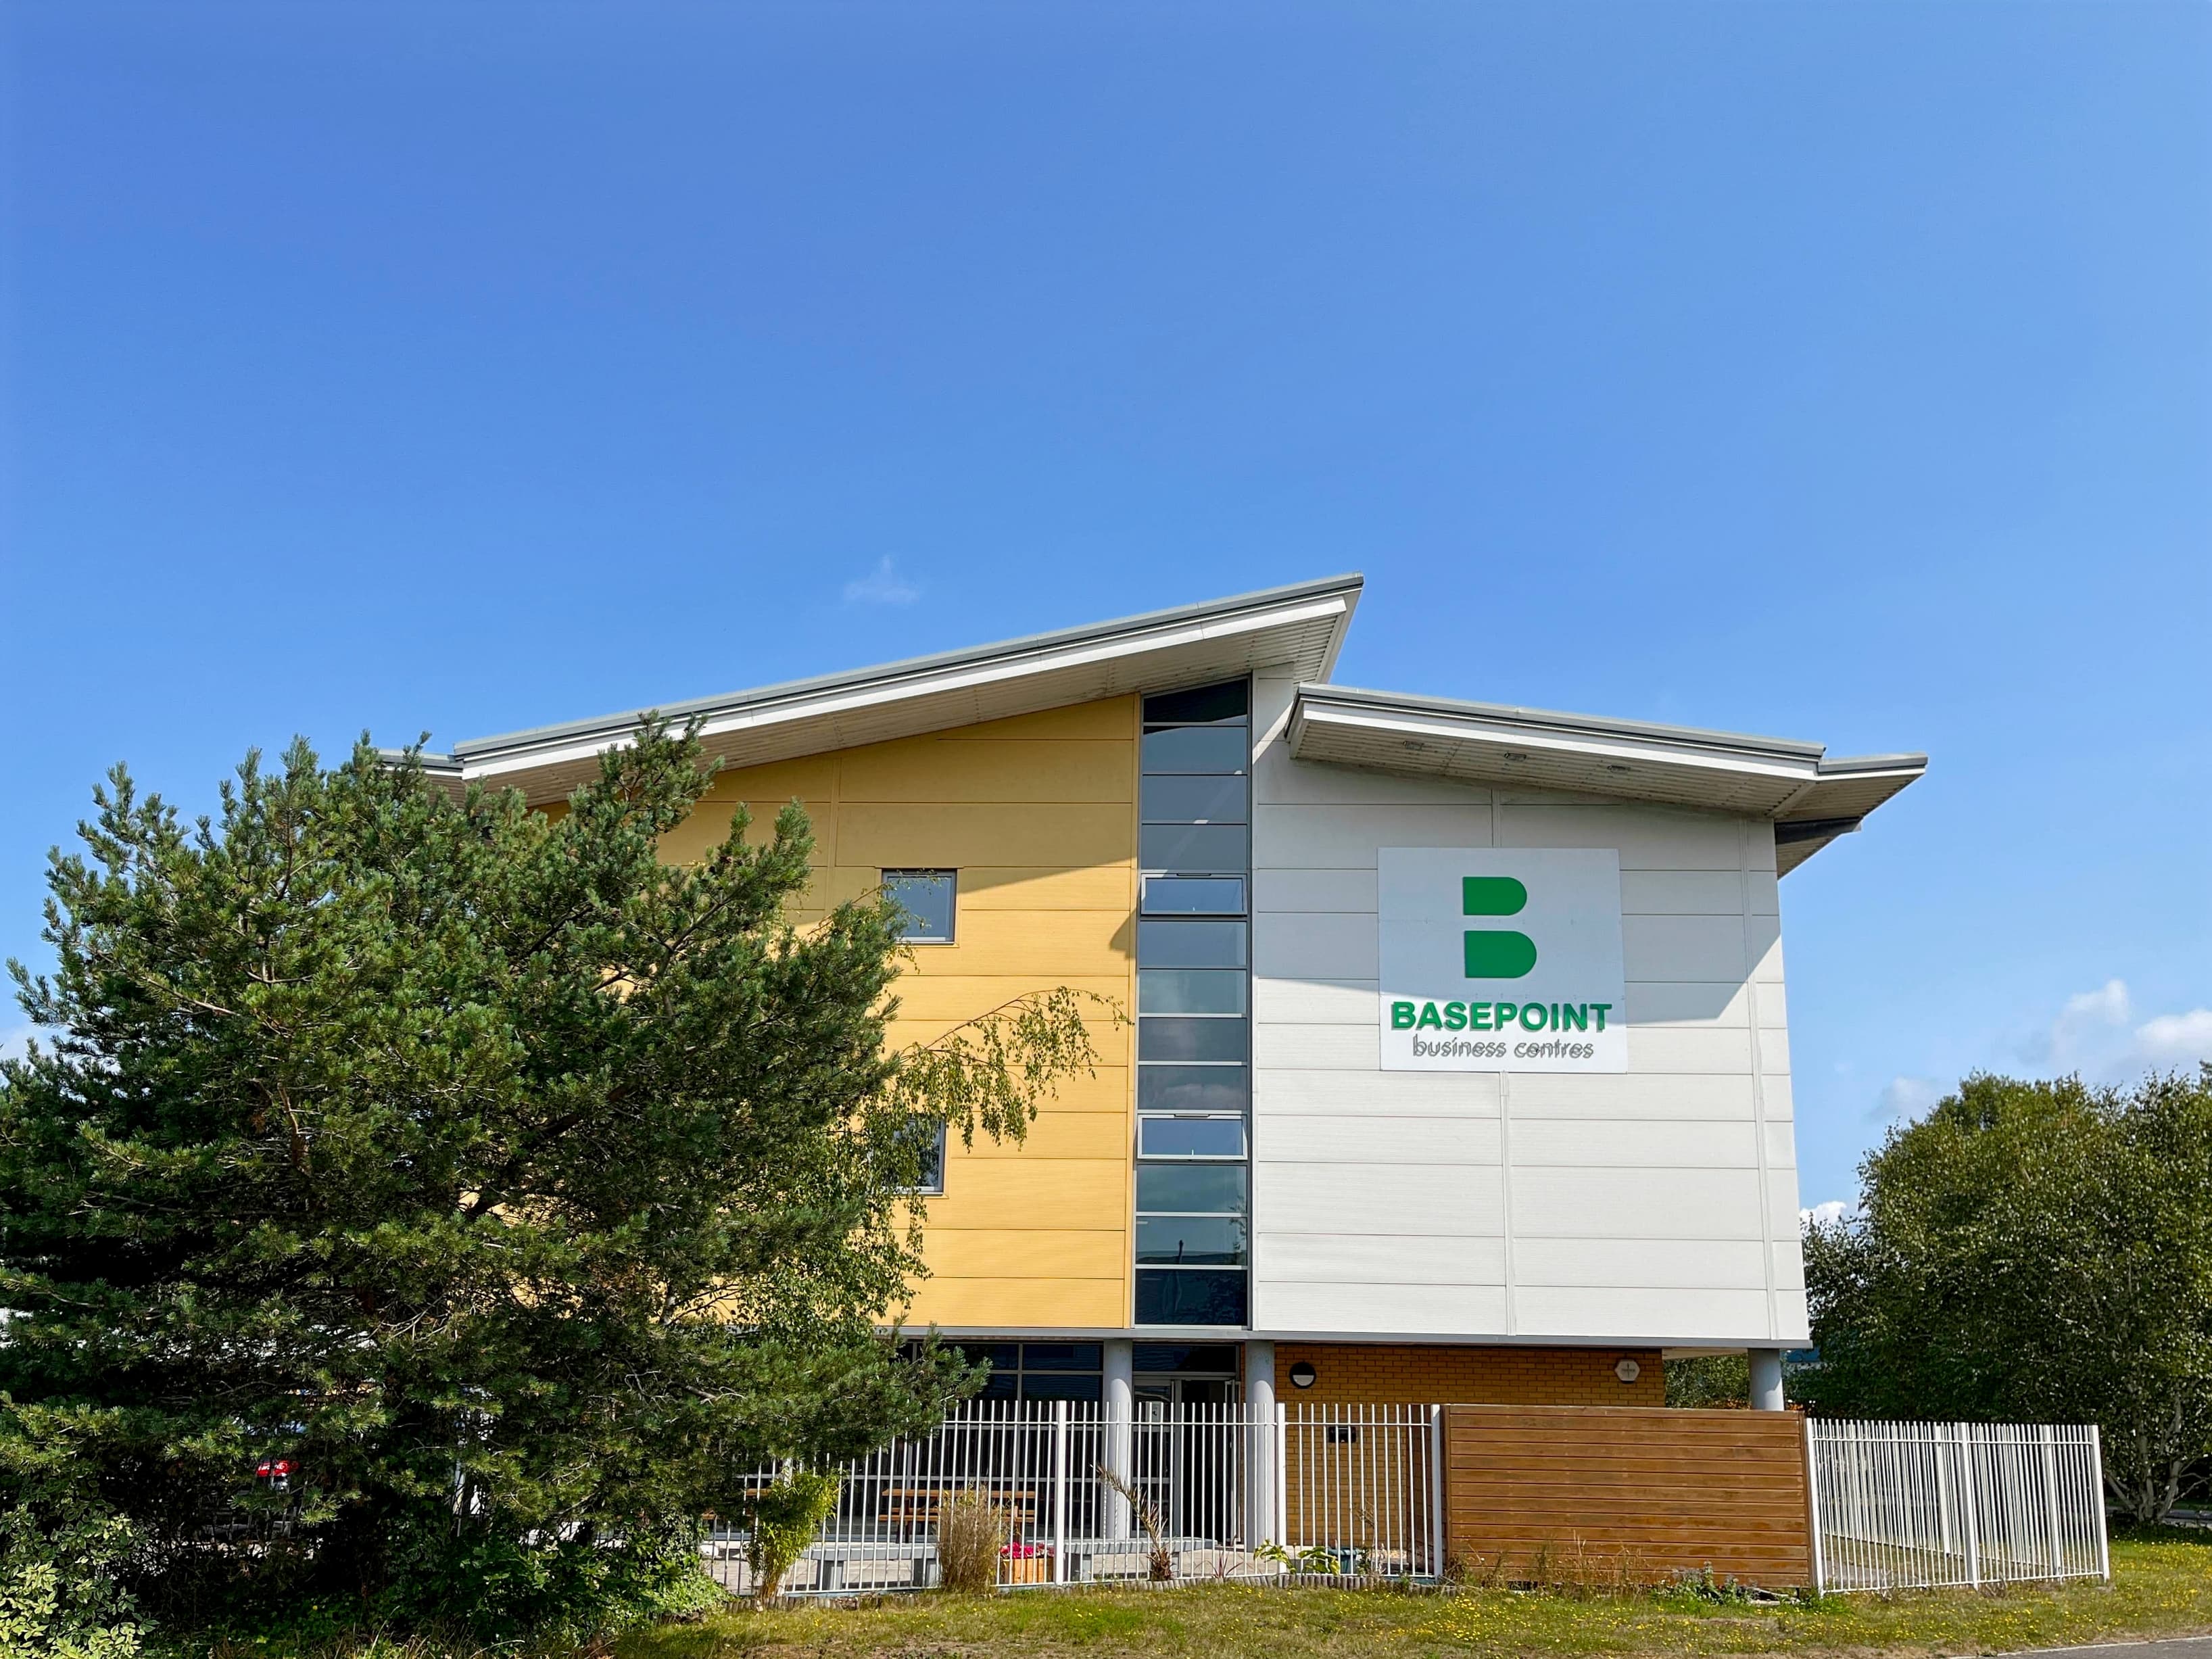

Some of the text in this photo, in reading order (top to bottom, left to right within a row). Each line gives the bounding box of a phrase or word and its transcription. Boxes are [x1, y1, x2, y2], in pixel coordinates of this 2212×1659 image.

[1462, 876, 1537, 978] B
[1391, 1001, 1612, 1032] BASEPOINT
[1412, 1034, 1594, 1059] business centres
